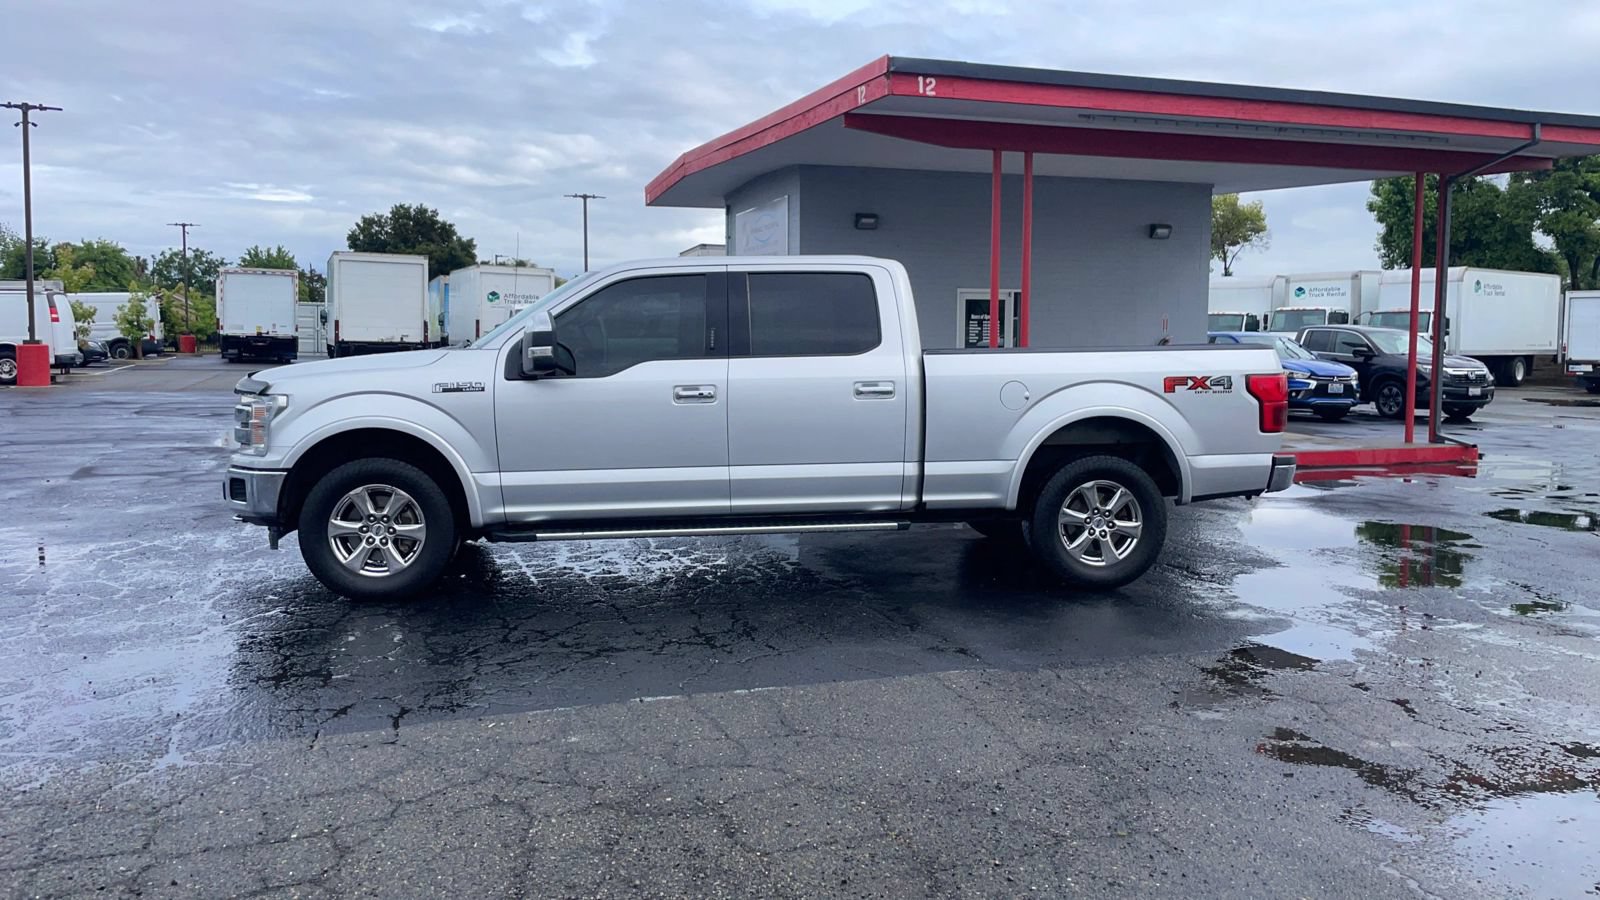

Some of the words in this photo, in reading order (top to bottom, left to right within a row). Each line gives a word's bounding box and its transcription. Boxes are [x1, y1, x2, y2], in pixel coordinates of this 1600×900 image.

[857, 85, 867, 105] 12
[917, 76, 937, 97] 12
[503, 293, 540, 301] Affordable
[1163, 375, 1233, 393] FX4
